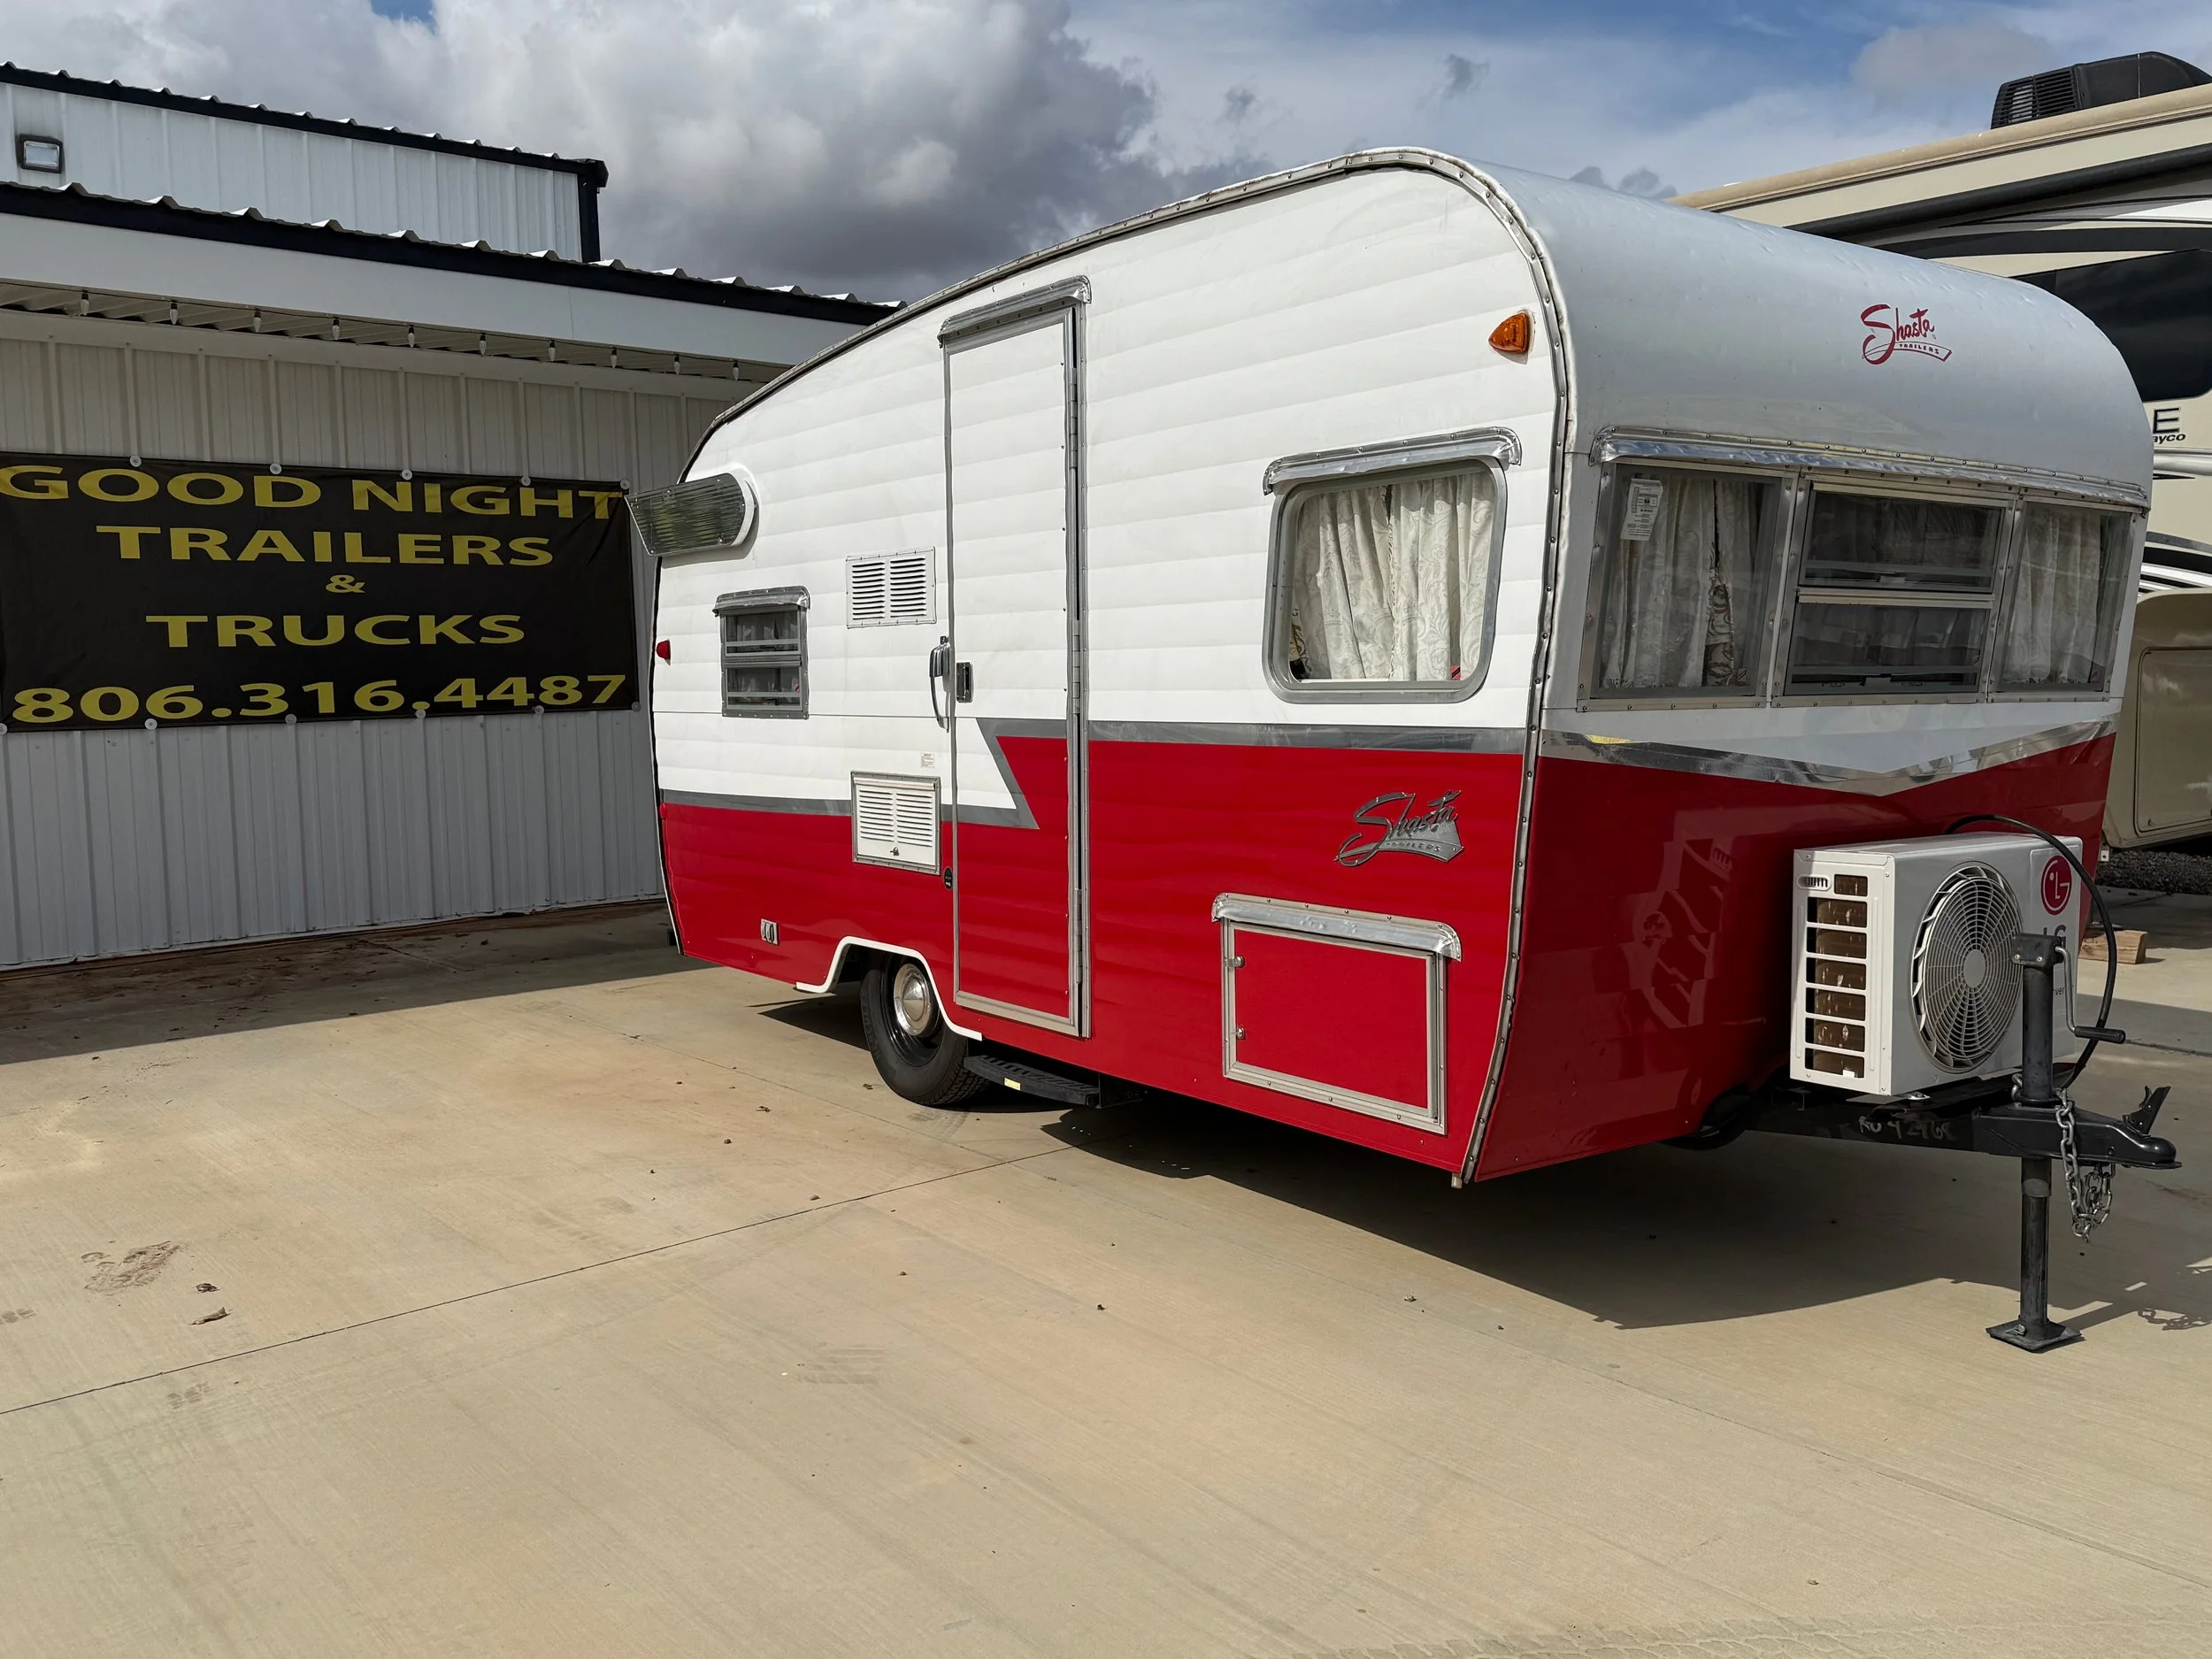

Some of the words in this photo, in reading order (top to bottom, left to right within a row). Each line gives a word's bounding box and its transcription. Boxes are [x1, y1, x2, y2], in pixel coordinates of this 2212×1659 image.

[1860, 303, 1935, 365] Shasta
[1898, 342, 1940, 356] TRAILERS
[2152, 434, 2186, 444] ayco
[0, 465, 321, 508] GOOD
[352, 480, 623, 520] NIGHT
[96, 526, 553, 566] TRAILERS
[326, 575, 365, 594] &
[146, 615, 525, 648] TRUCKS
[12, 674, 626, 723] 806.316.4487
[1336, 790, 1459, 866] Shasta
